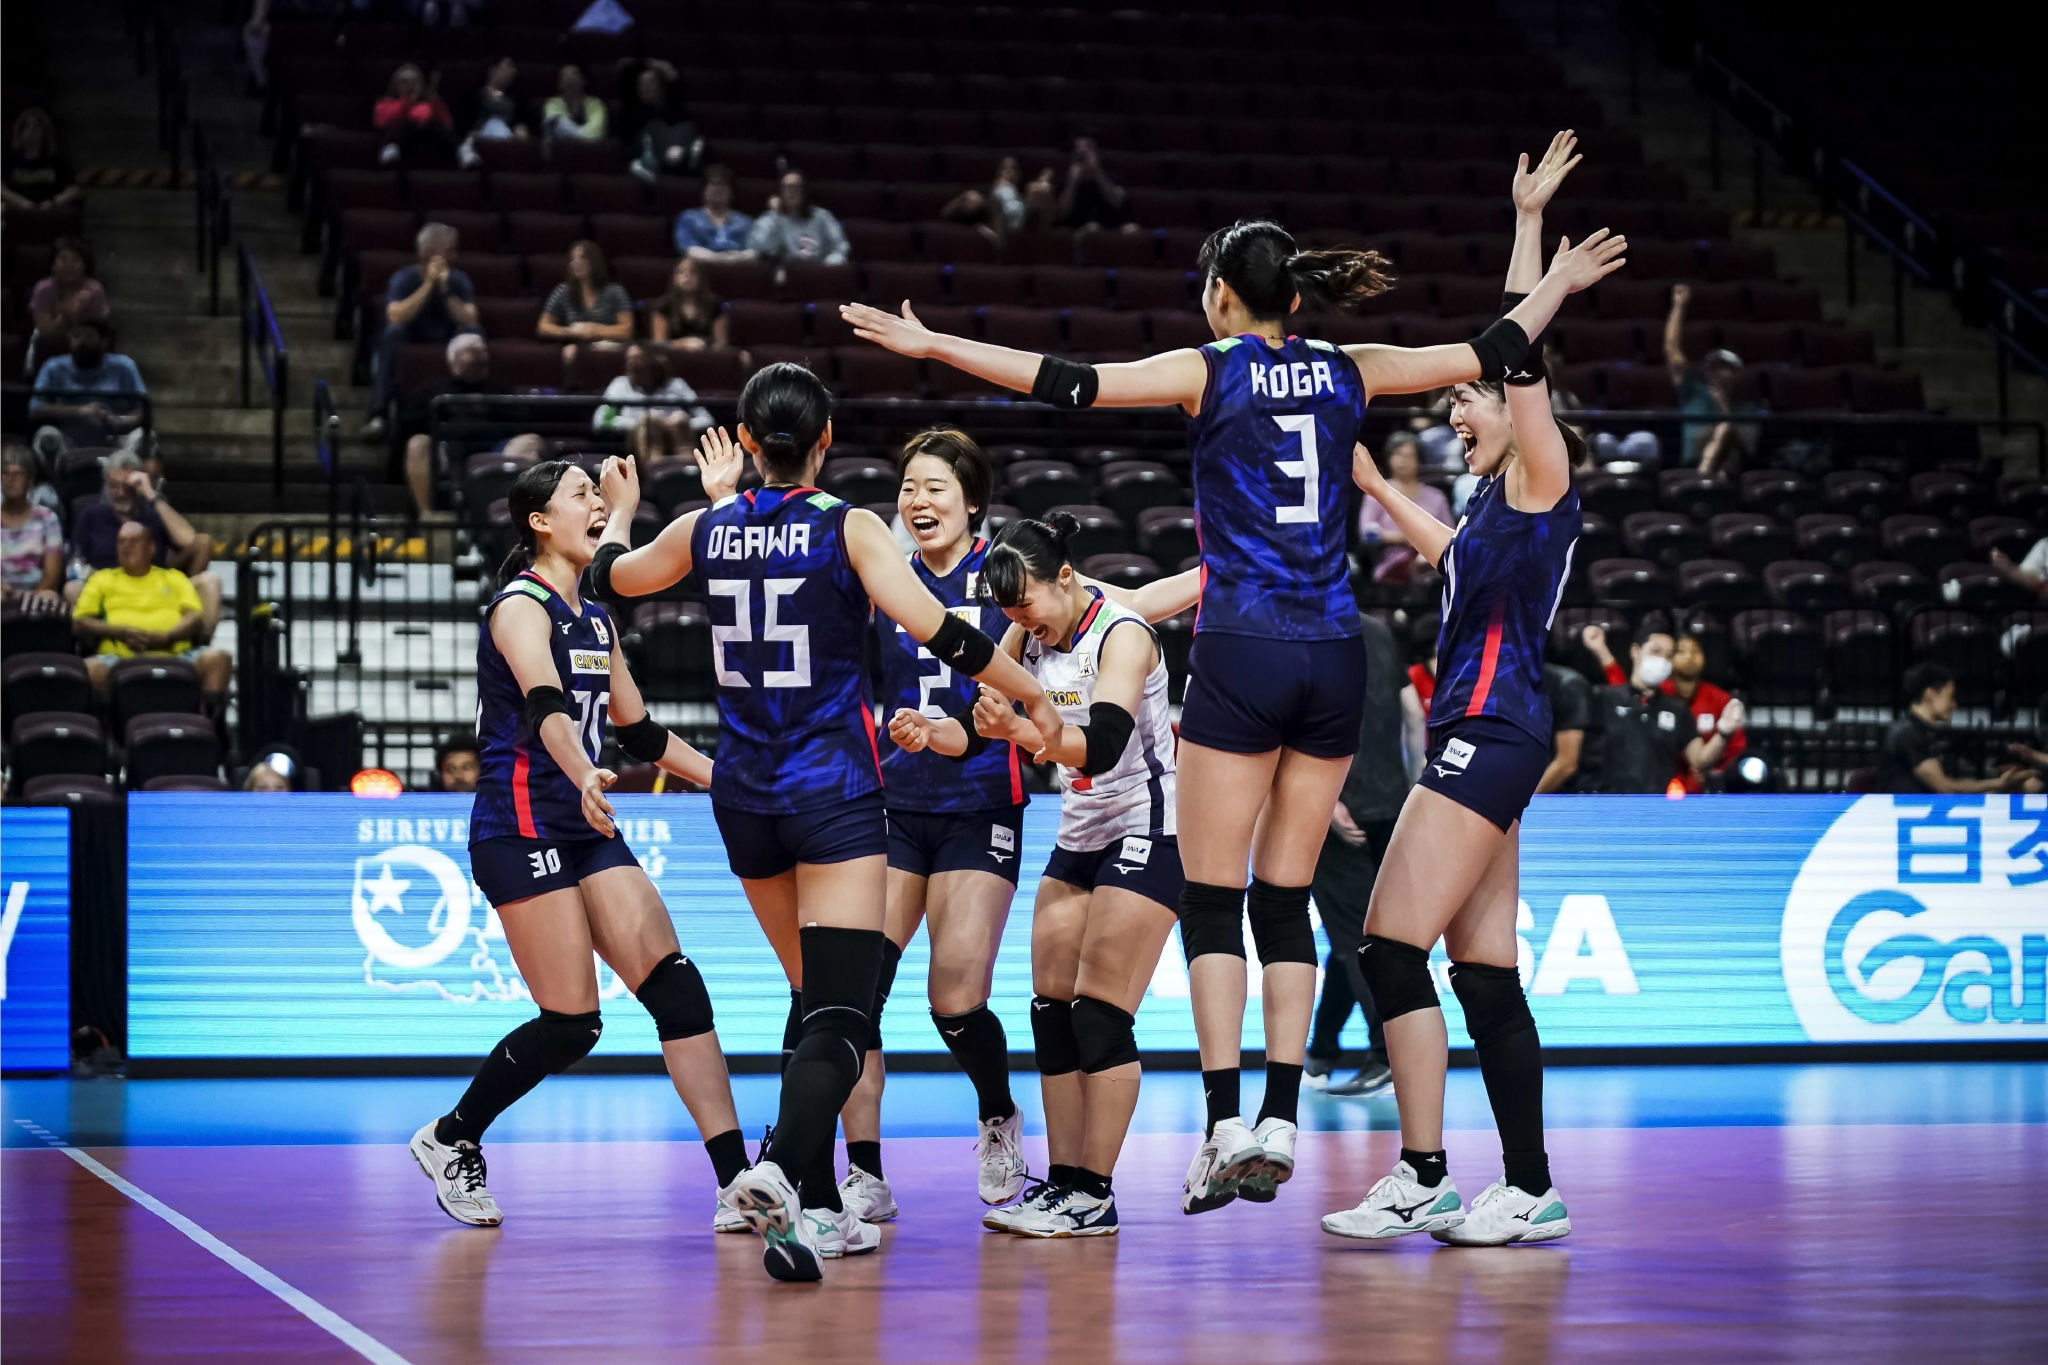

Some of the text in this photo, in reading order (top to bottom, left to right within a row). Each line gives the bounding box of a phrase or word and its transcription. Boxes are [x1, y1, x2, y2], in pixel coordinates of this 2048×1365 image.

[1250, 361, 1335, 398] KOGA
[1272, 414, 1320, 524] 3
[707, 523, 811, 560] OGAWA
[708, 578, 811, 688] 25
[574, 654, 610, 670] CAPCOM
[1046, 689, 1082, 706] PCOM
[358, 818, 468, 843] SHREVE
[527, 848, 562, 879] 30
